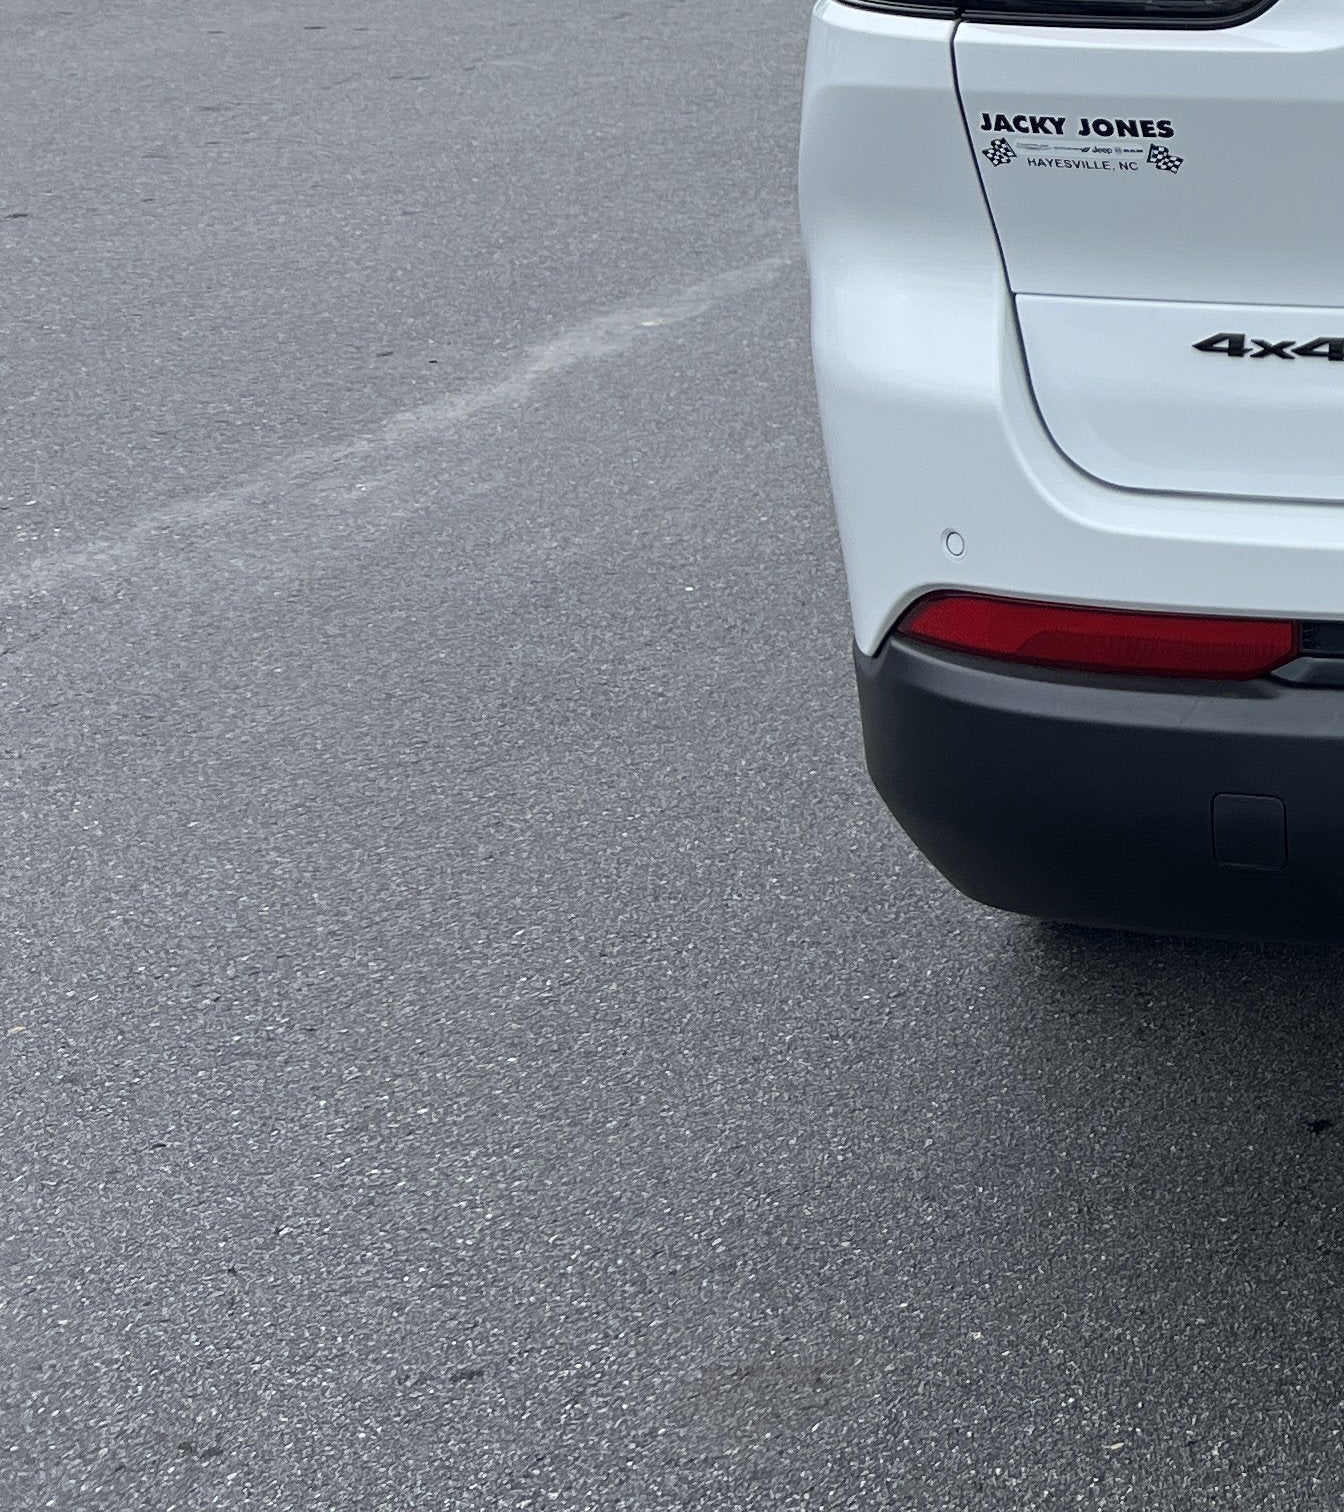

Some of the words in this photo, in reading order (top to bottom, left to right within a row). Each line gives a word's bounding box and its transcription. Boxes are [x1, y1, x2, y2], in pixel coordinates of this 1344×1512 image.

[980, 112, 1066, 136] JACKY
[1078, 117, 1175, 139] JONES
[1026, 157, 1116, 172] HAYESVILLE,
[1119, 160, 1139, 171] NC
